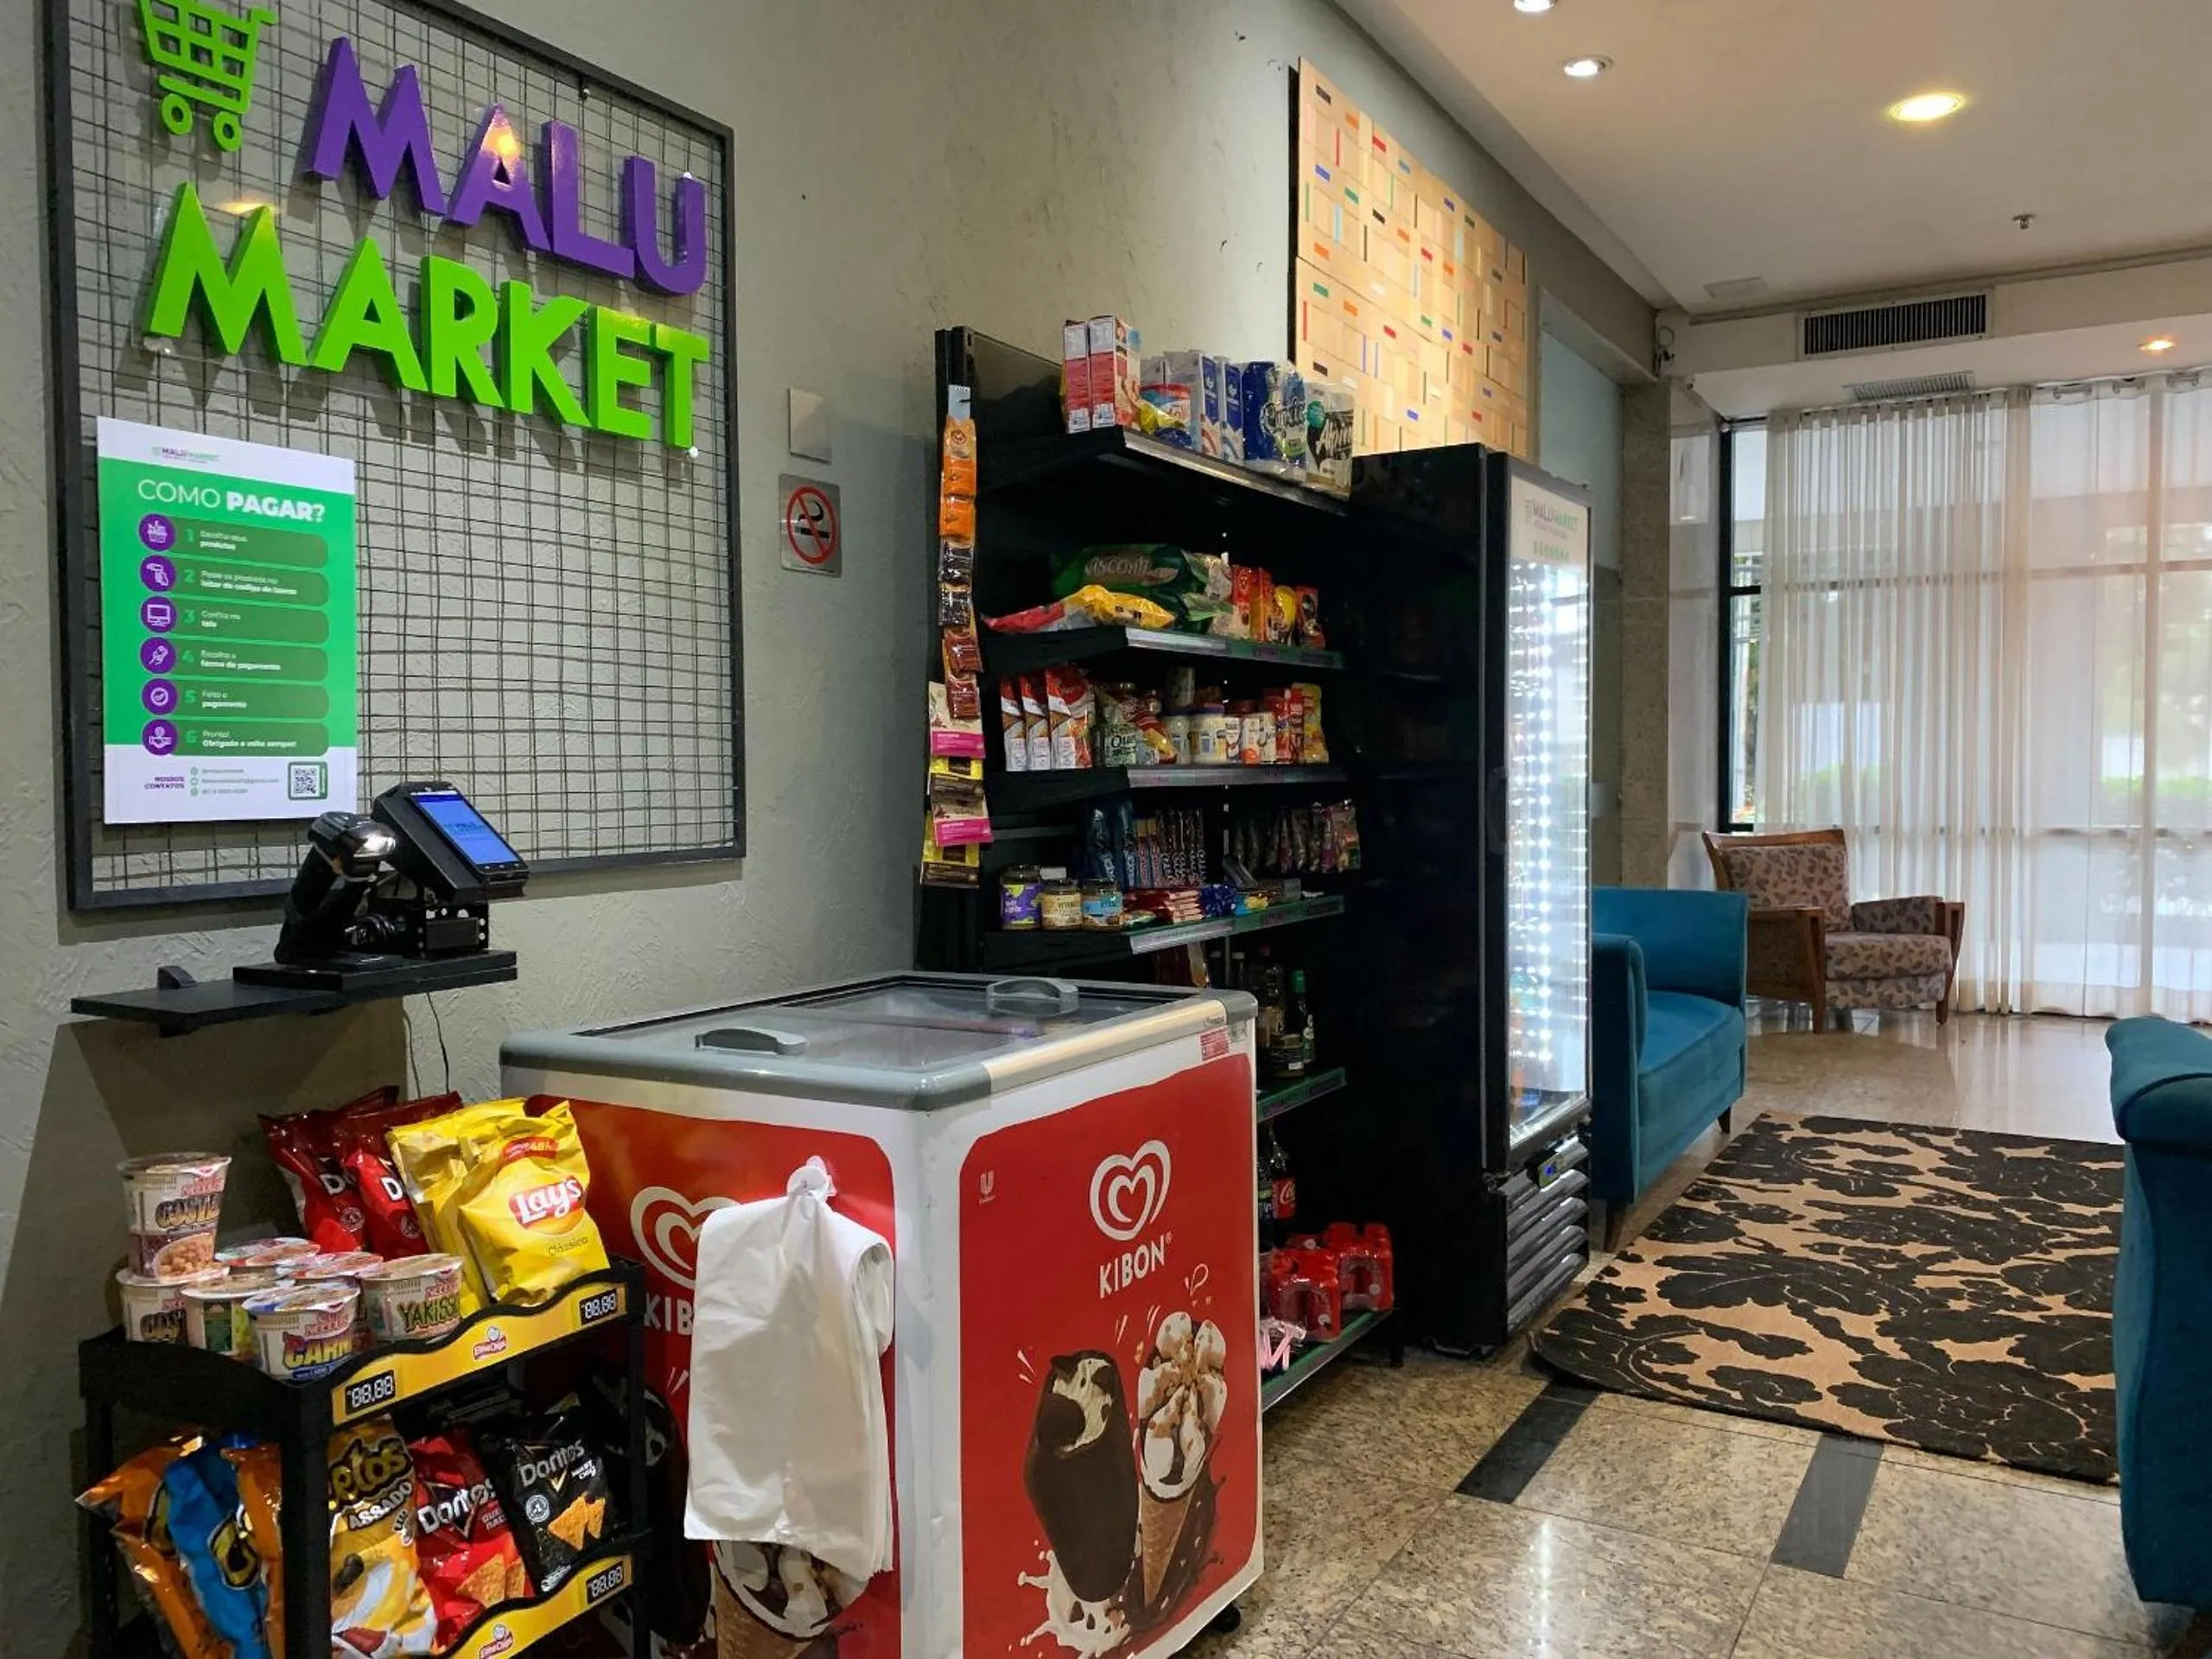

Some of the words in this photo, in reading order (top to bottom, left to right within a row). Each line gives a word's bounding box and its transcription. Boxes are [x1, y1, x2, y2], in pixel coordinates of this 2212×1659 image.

[312, 36, 708, 296] MALU
[142, 181, 710, 450] MARKET
[137, 479, 220, 509] COMO
[226, 490, 326, 524] PAGAR?
[184, 689, 196, 704] 5
[514, 1178, 582, 1224] Lay's
[1098, 1235, 1166, 1299] KIBON
[644, 1292, 695, 1337] KIB
[519, 1438, 585, 1487] Doritos
[348, 1481, 413, 1529] ASSADO
